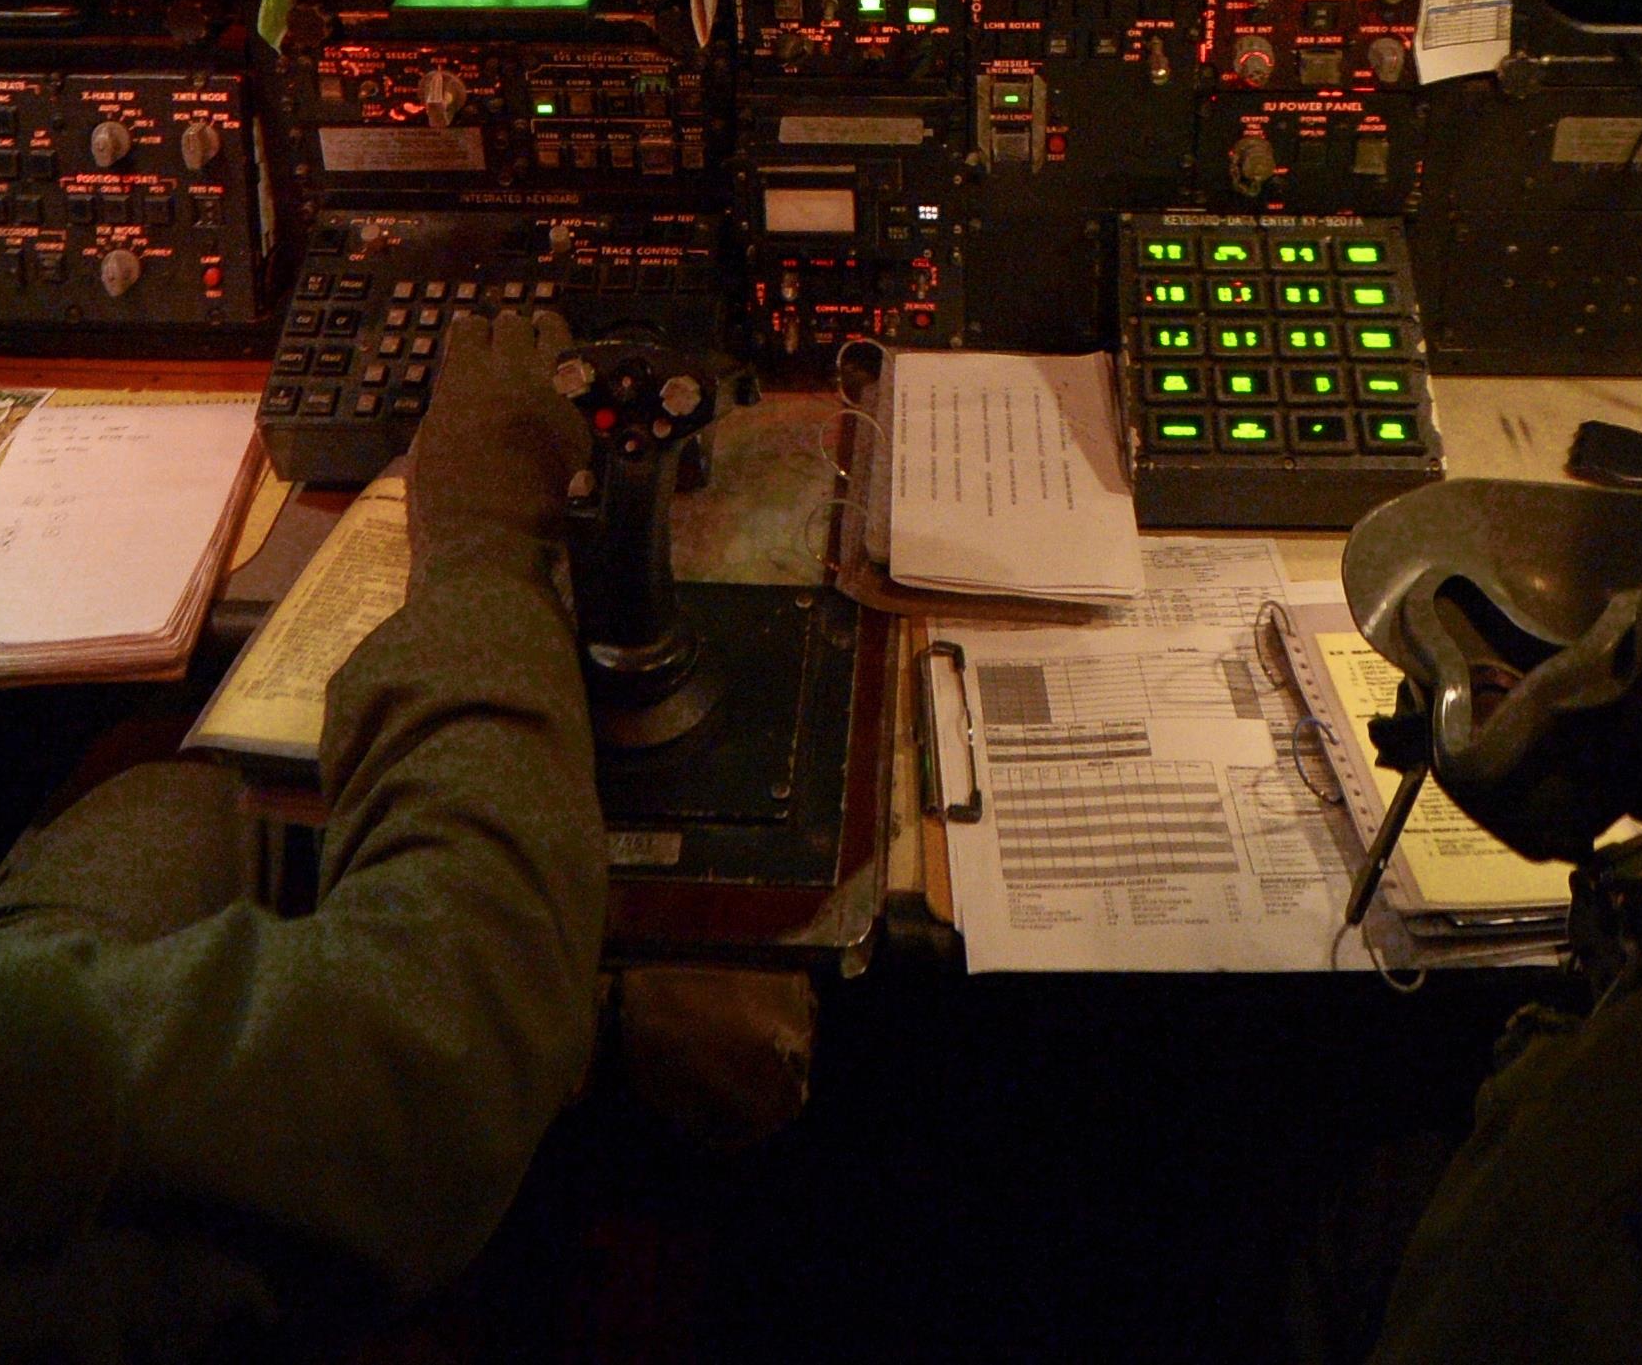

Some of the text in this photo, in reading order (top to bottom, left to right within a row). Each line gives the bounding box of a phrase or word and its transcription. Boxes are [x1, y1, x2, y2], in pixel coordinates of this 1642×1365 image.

[1009, 22, 1041, 30] ROTATE
[385, 52, 419, 60] SELECT
[1279, 102, 1363, 111] POWER PANEL
[601, 246, 683, 255] TRACK CONTROL
